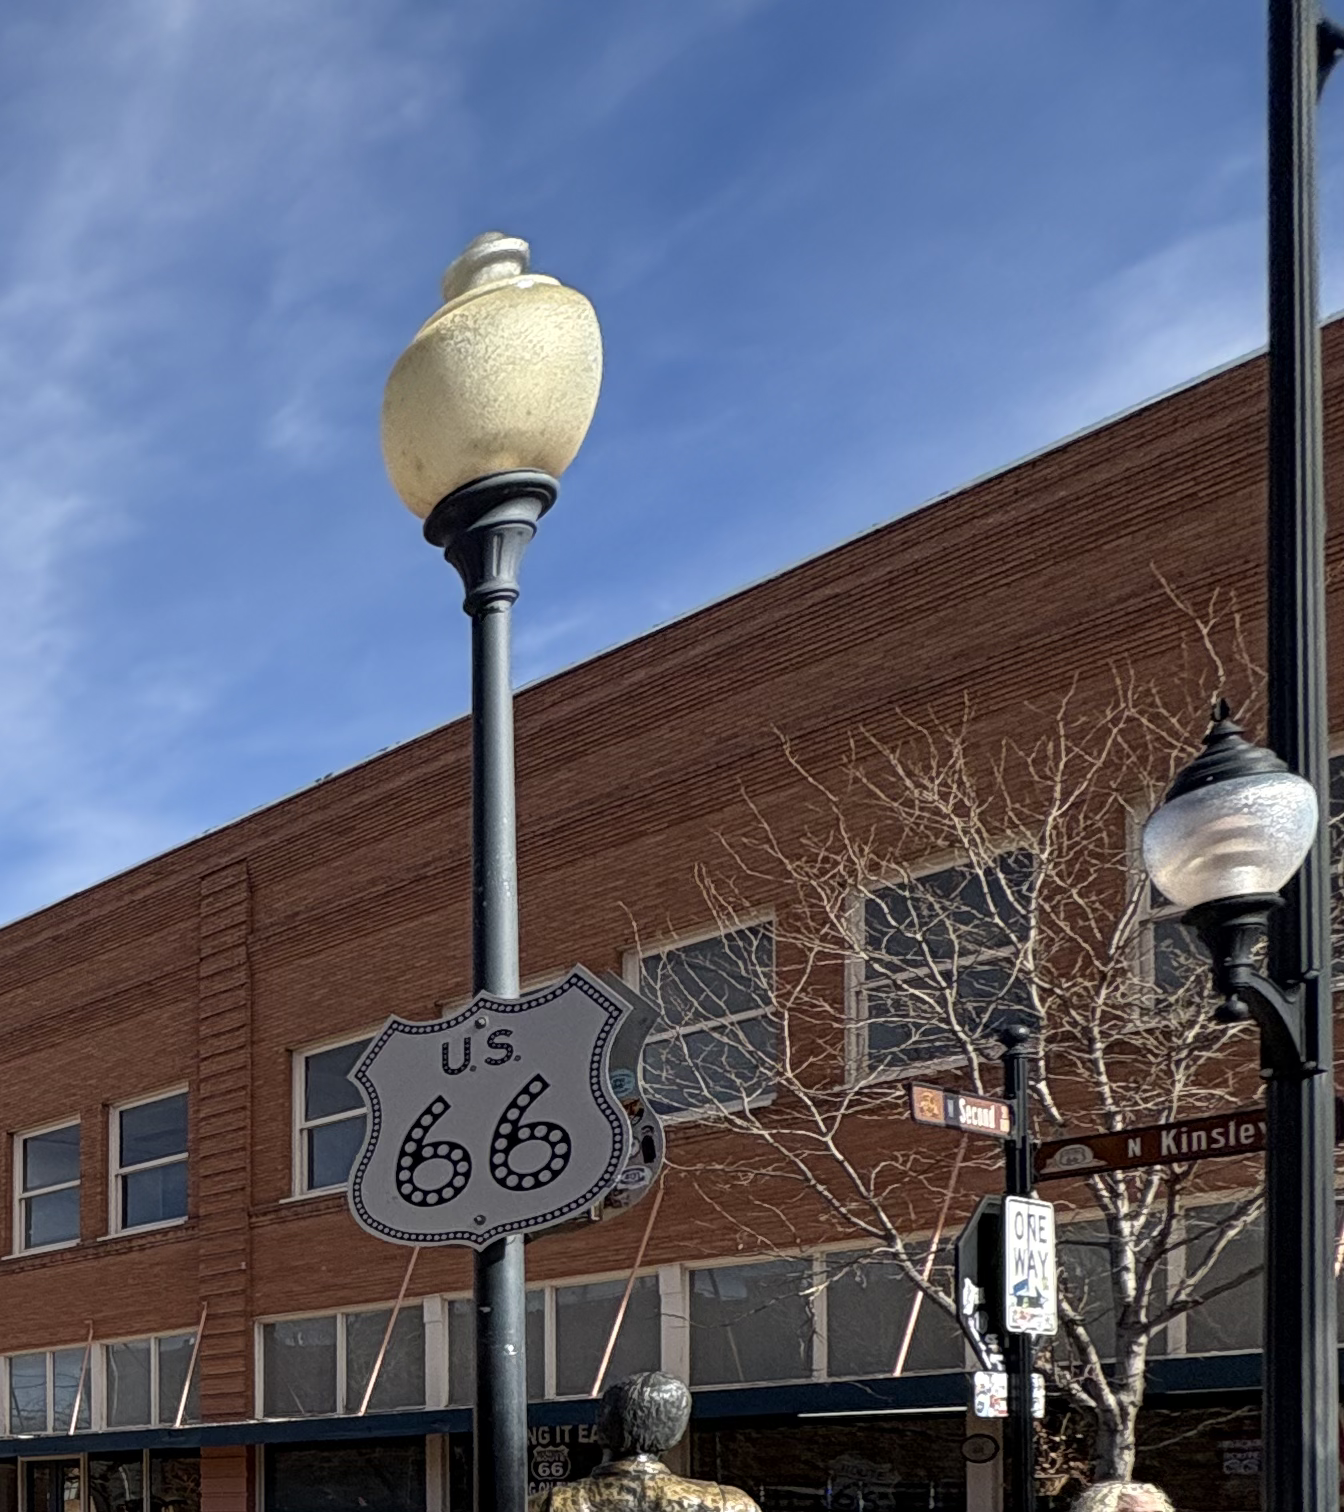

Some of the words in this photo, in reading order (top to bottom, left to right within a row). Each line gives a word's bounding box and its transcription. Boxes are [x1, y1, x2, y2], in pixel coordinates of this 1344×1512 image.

[958, 1097, 996, 1129] Second
[395, 1072, 573, 1208] 66
[1127, 1137, 1142, 1158] N
[1014, 1211, 1048, 1244] ONE
[1014, 1247, 1049, 1280] WAY
[537, 1462, 564, 1477] 66
